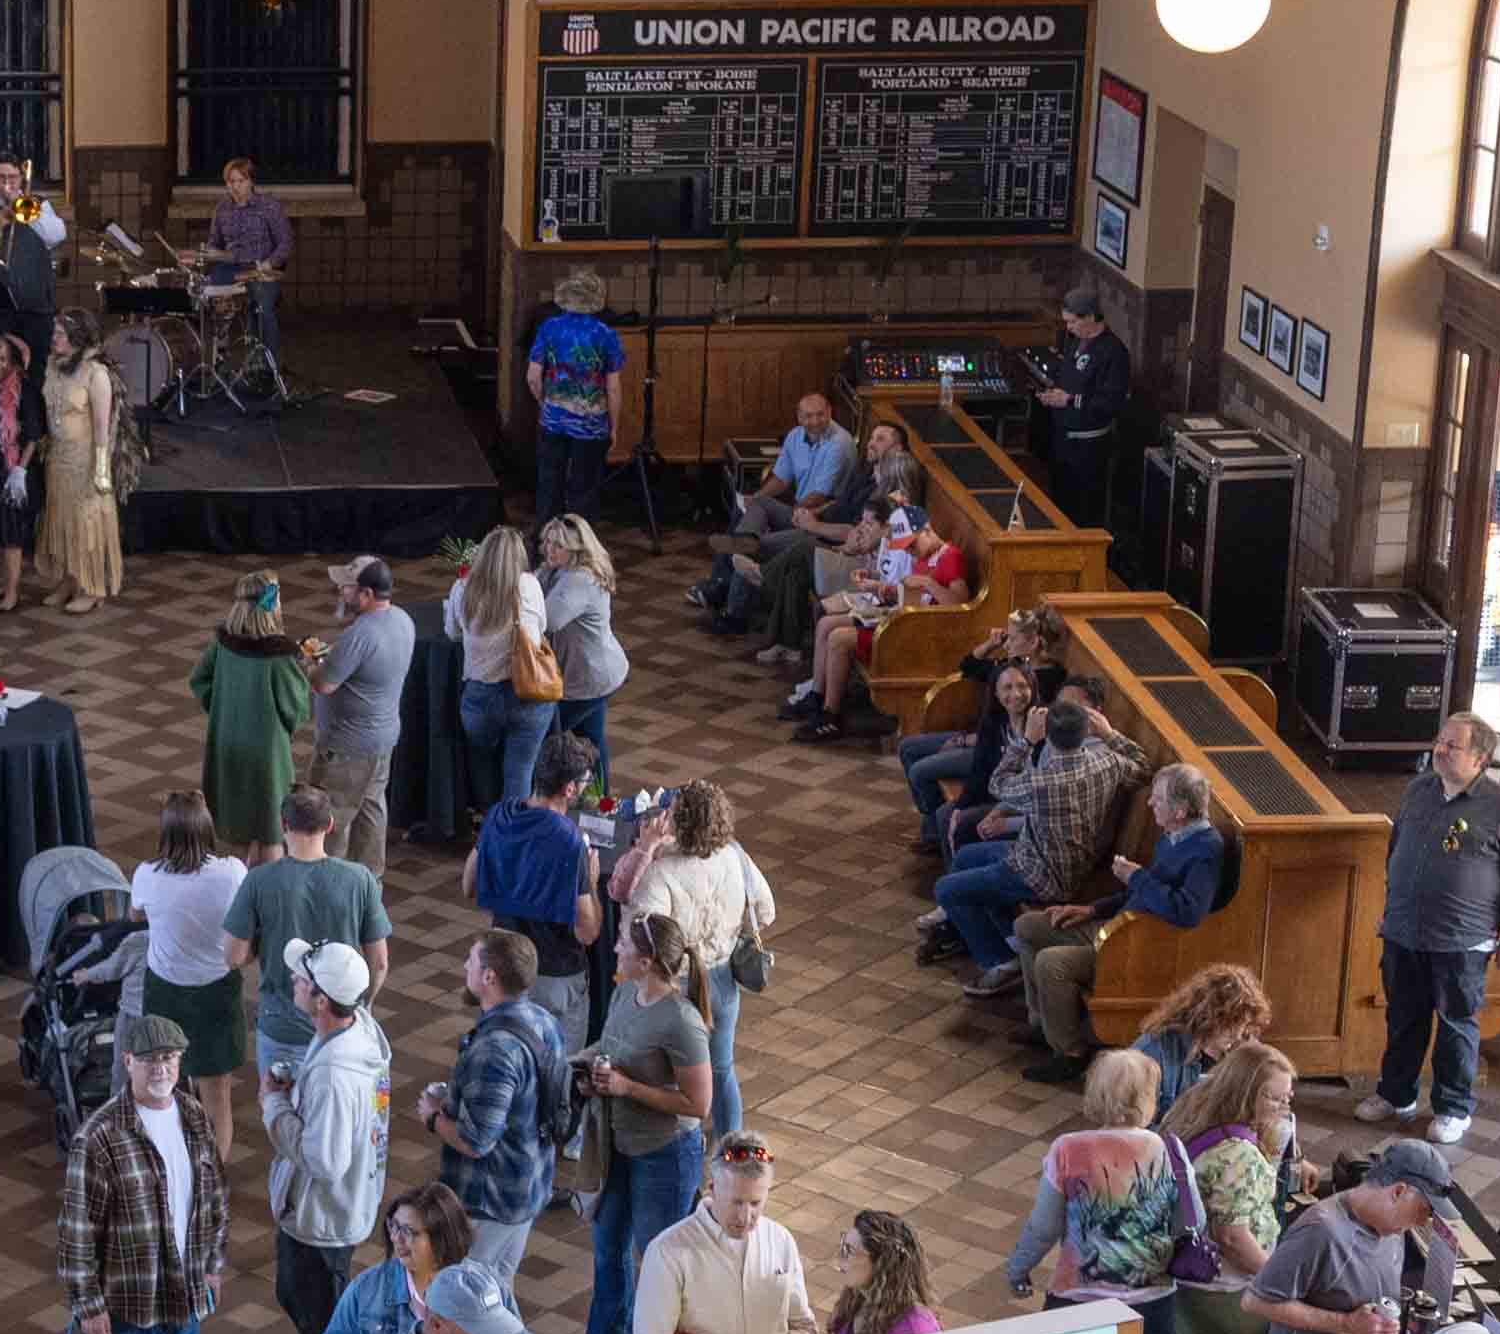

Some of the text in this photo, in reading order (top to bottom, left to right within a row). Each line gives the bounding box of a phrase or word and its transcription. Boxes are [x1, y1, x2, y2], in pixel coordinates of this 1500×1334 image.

[634, 16, 1056, 45] UNION PACIFIC RAILROAD
[585, 70, 622, 82] SALT
[624, 70, 666, 81] LAKE
[667, 69, 702, 81] CITY
[715, 69, 758, 80] BOISE
[859, 67, 897, 78] SALT
[899, 67, 939, 78] LAKE
[941, 67, 976, 77] CITY
[988, 66, 1031, 76] BOISE
[587, 81, 673, 93] PENDLETON
[685, 80, 757, 91] SPOKANE
[872, 78, 951, 89] PORTLAND
[962, 77, 1027, 87] SEATTLE
